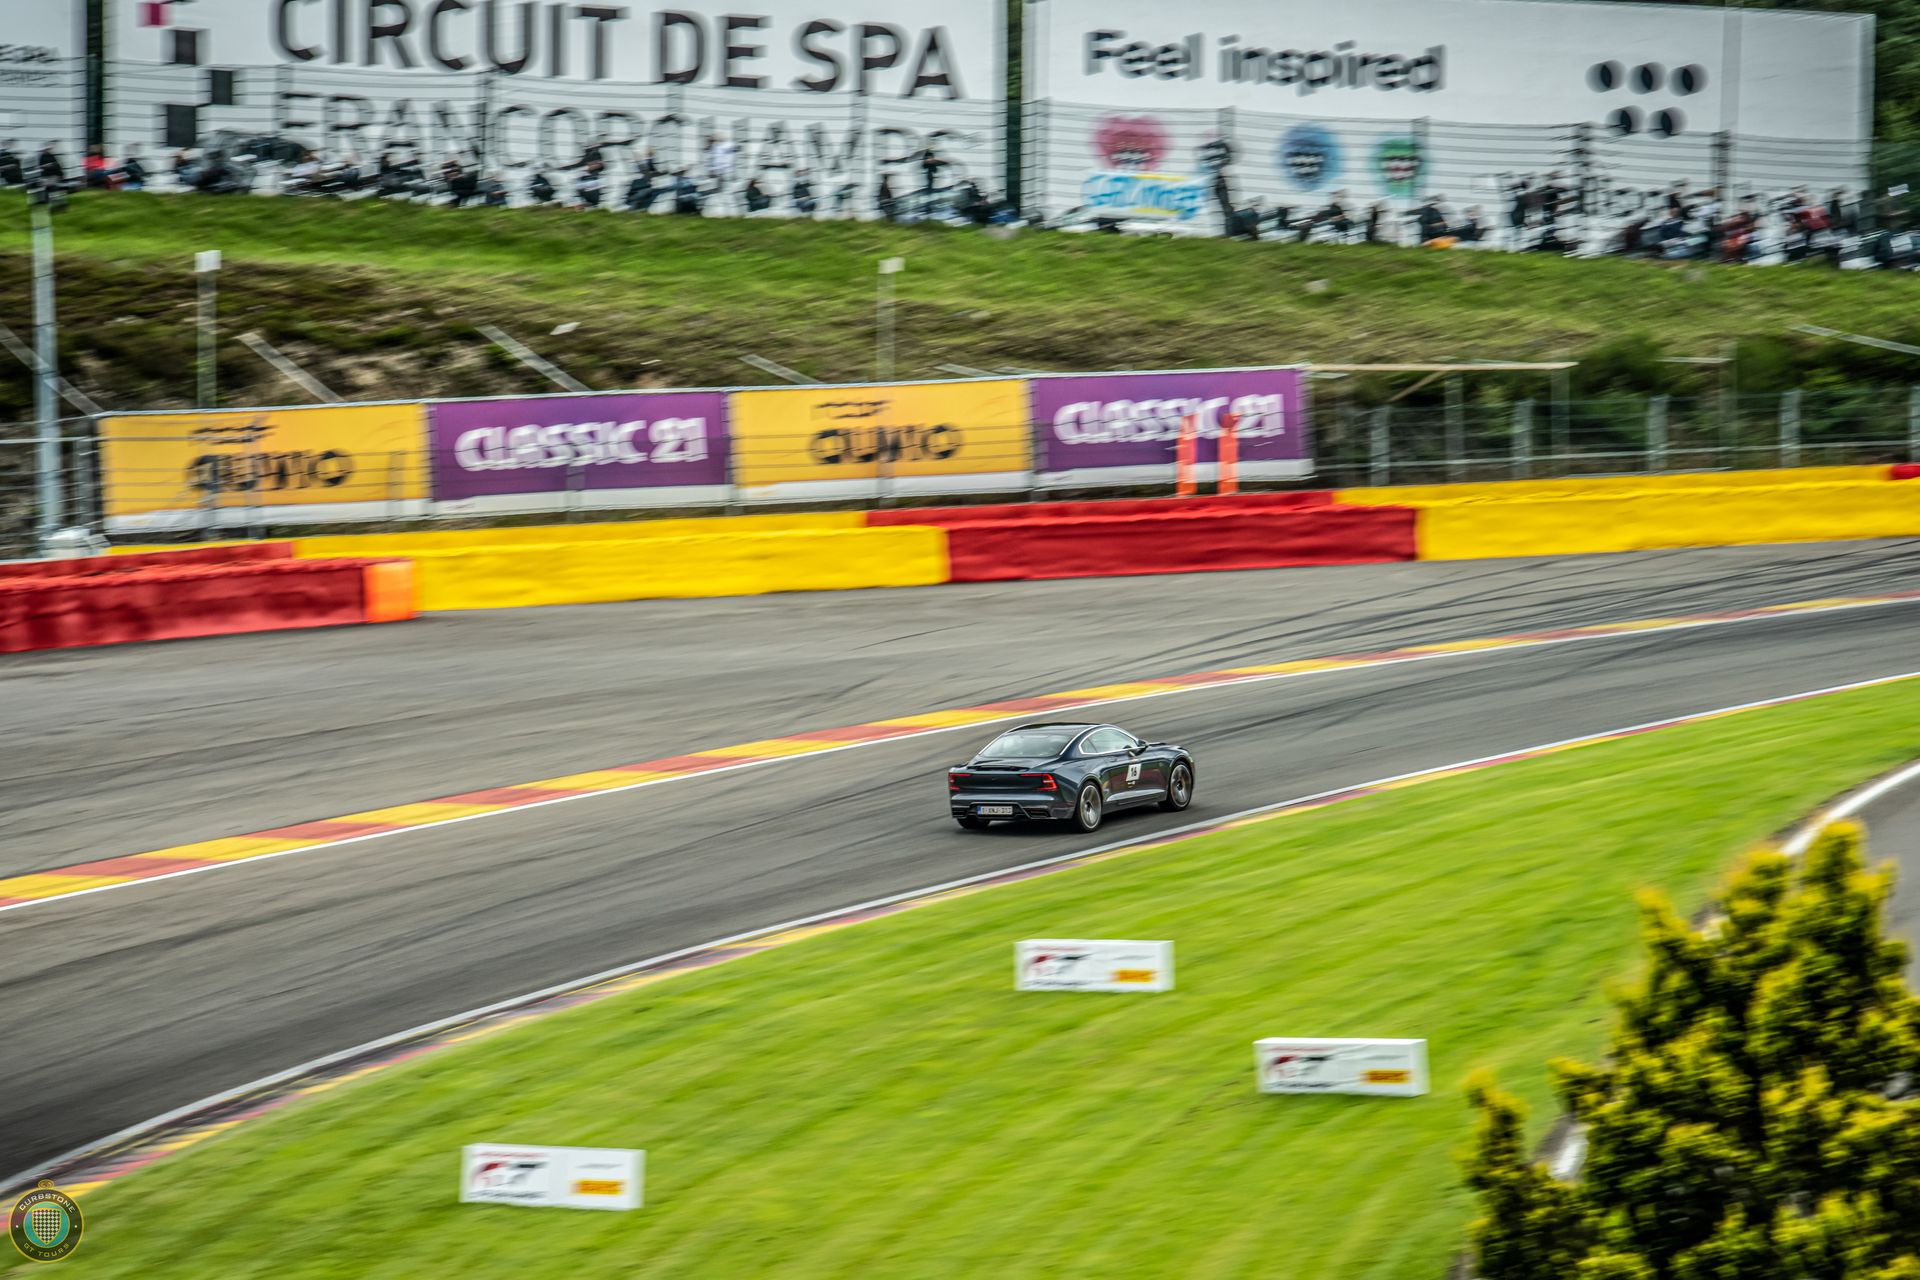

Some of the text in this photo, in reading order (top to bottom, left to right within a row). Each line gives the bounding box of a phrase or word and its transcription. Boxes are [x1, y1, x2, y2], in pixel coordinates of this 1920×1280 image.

[270, 0, 967, 100] CIRCUIT DE SPA
[1082, 31, 1446, 97] Feel inspired
[454, 417, 709, 472] CLASSIC 21
[1054, 394, 1285, 445] CLASSIC 21
